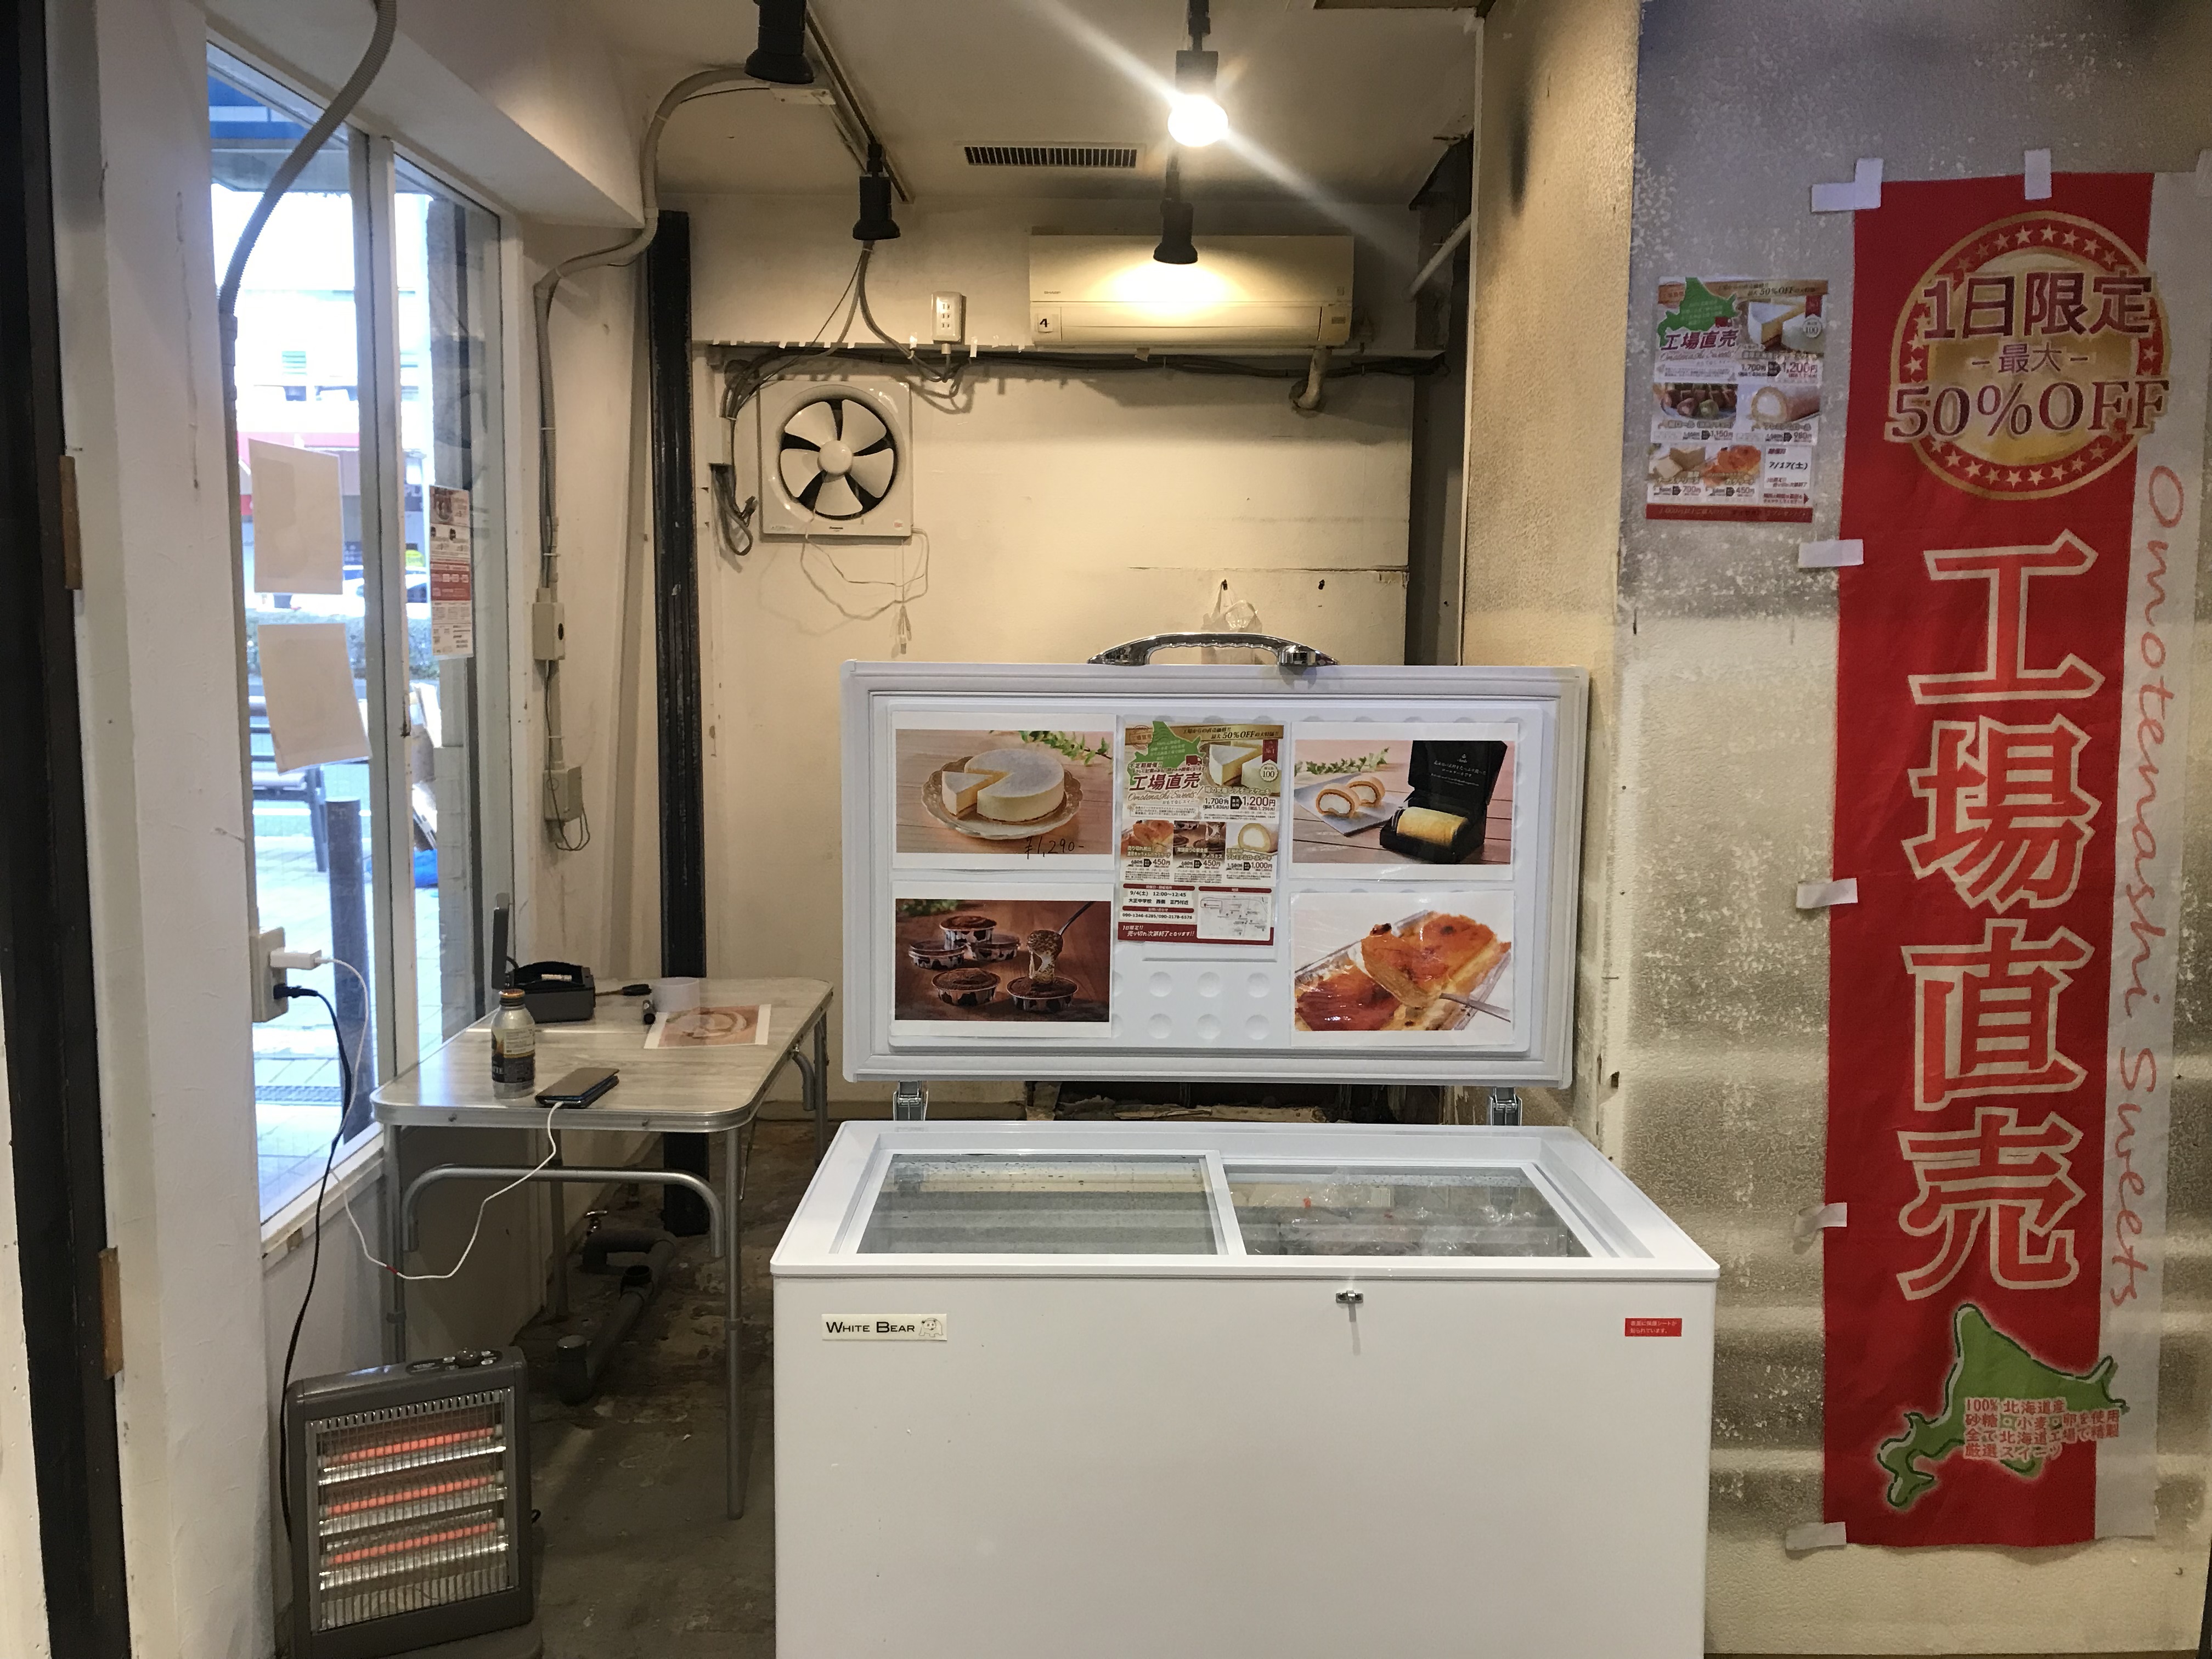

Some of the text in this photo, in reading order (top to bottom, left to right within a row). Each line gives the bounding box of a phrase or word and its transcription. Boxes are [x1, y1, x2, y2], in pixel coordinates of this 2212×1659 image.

[1923, 269, 2153, 339] 1日限定
[1040, 318, 1050, 328] 4
[1661, 330, 1739, 351] 工場直売
[1892, 379, 2170, 437] 50%OFF
[1769, 462, 1808, 470] 7/17(土)
[1129, 772, 1201, 791] 工場直売
[1128, 791, 1170, 801] Omotenashi
[1242, 796, 1276, 806] 1,200円
[2109, 465, 2184, 1307] Omotenashi Sweets
[1898, 528, 2104, 1301] 工場直売
